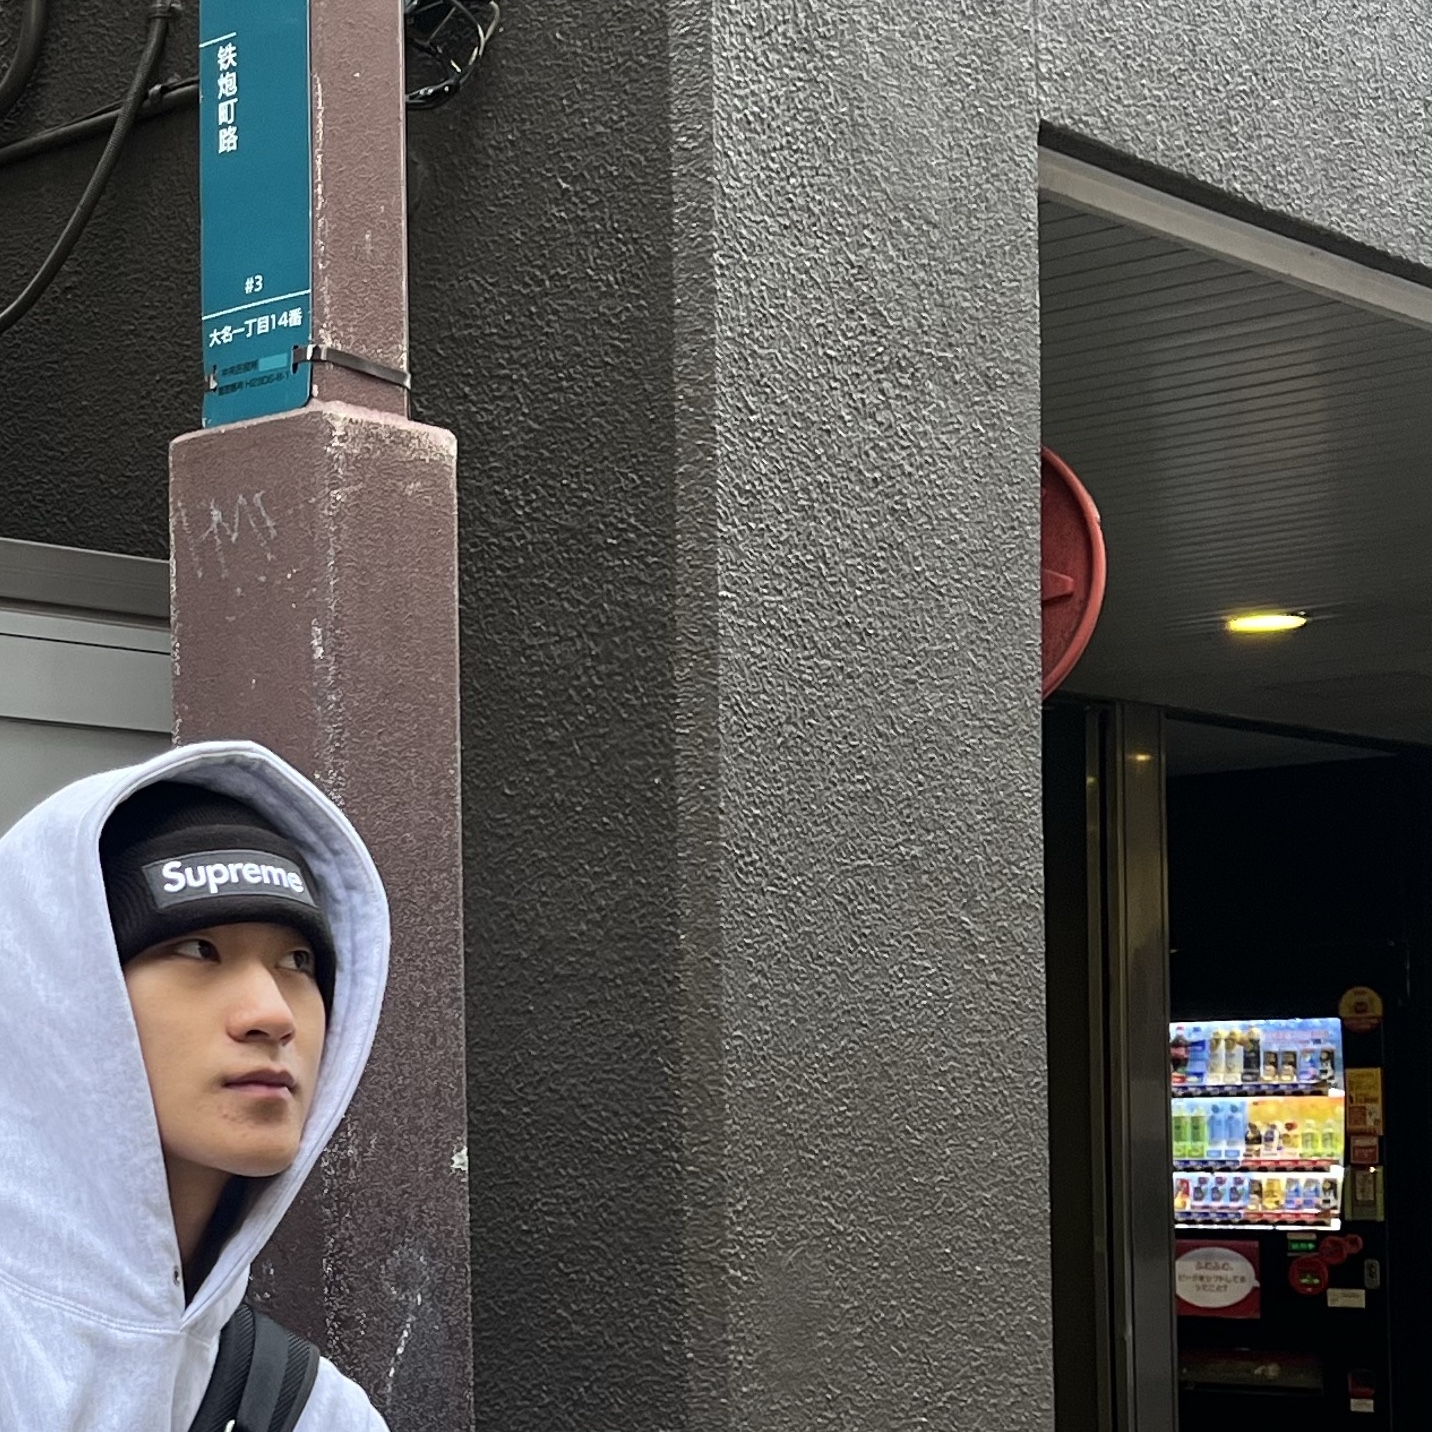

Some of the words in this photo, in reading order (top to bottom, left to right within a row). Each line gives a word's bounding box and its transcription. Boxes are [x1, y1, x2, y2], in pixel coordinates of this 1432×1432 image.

[244, 274, 263, 294] #3
[209, 307, 303, 348] 大名一丁目14番
[162, 861, 304, 894] Supreme
